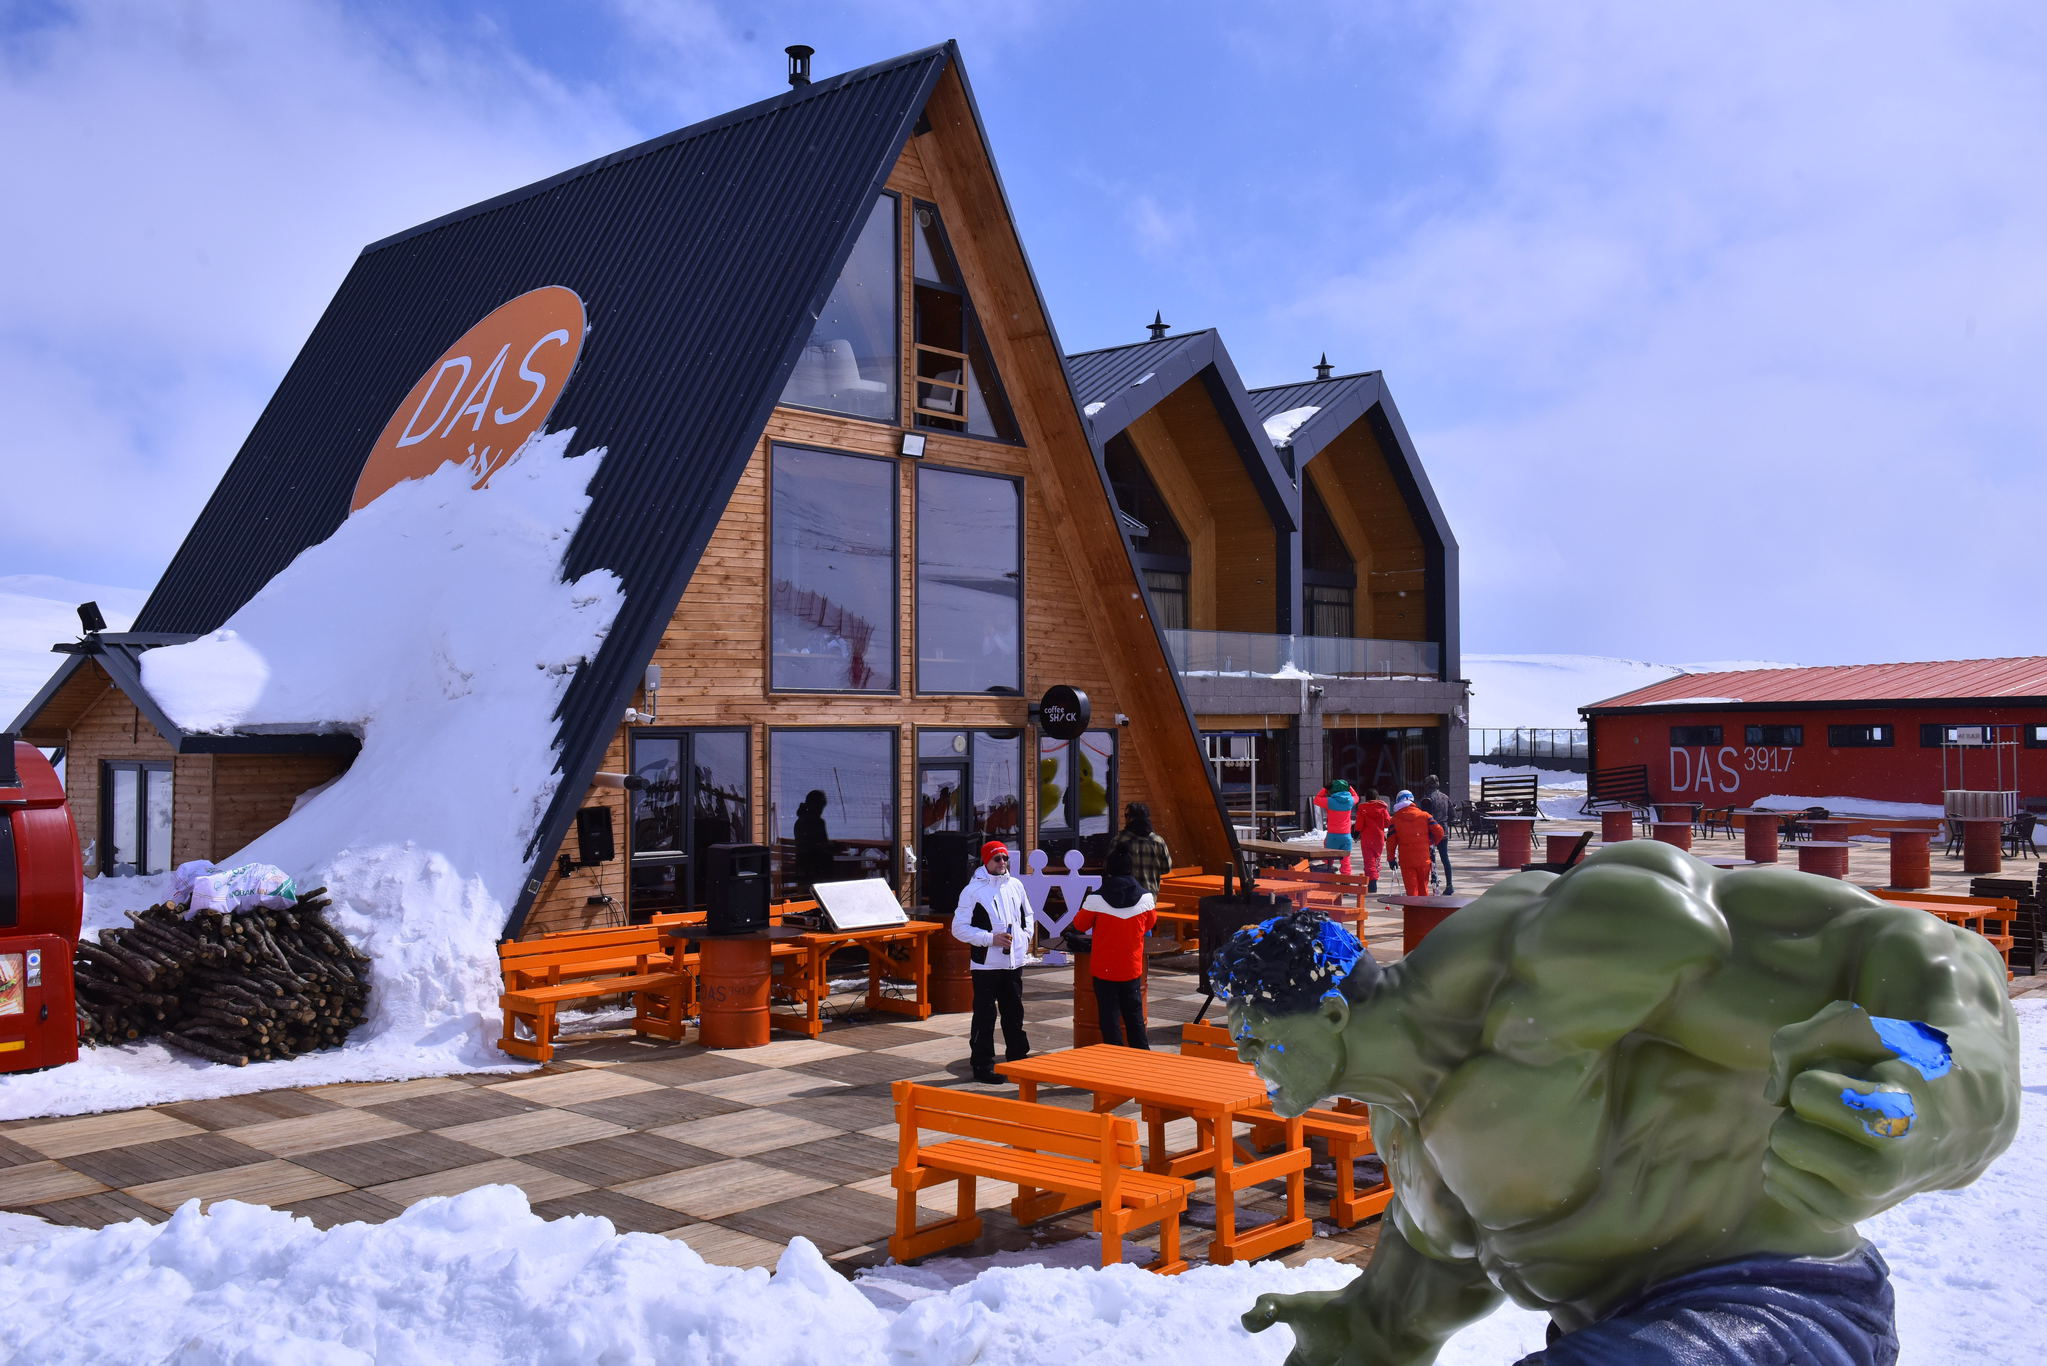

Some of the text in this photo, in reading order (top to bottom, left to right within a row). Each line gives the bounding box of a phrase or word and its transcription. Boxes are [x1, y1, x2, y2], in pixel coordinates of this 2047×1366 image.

[395, 328, 569, 448] DAS
[1044, 705, 1065, 714] coffee
[1670, 746, 1793, 793] DAS 3917
